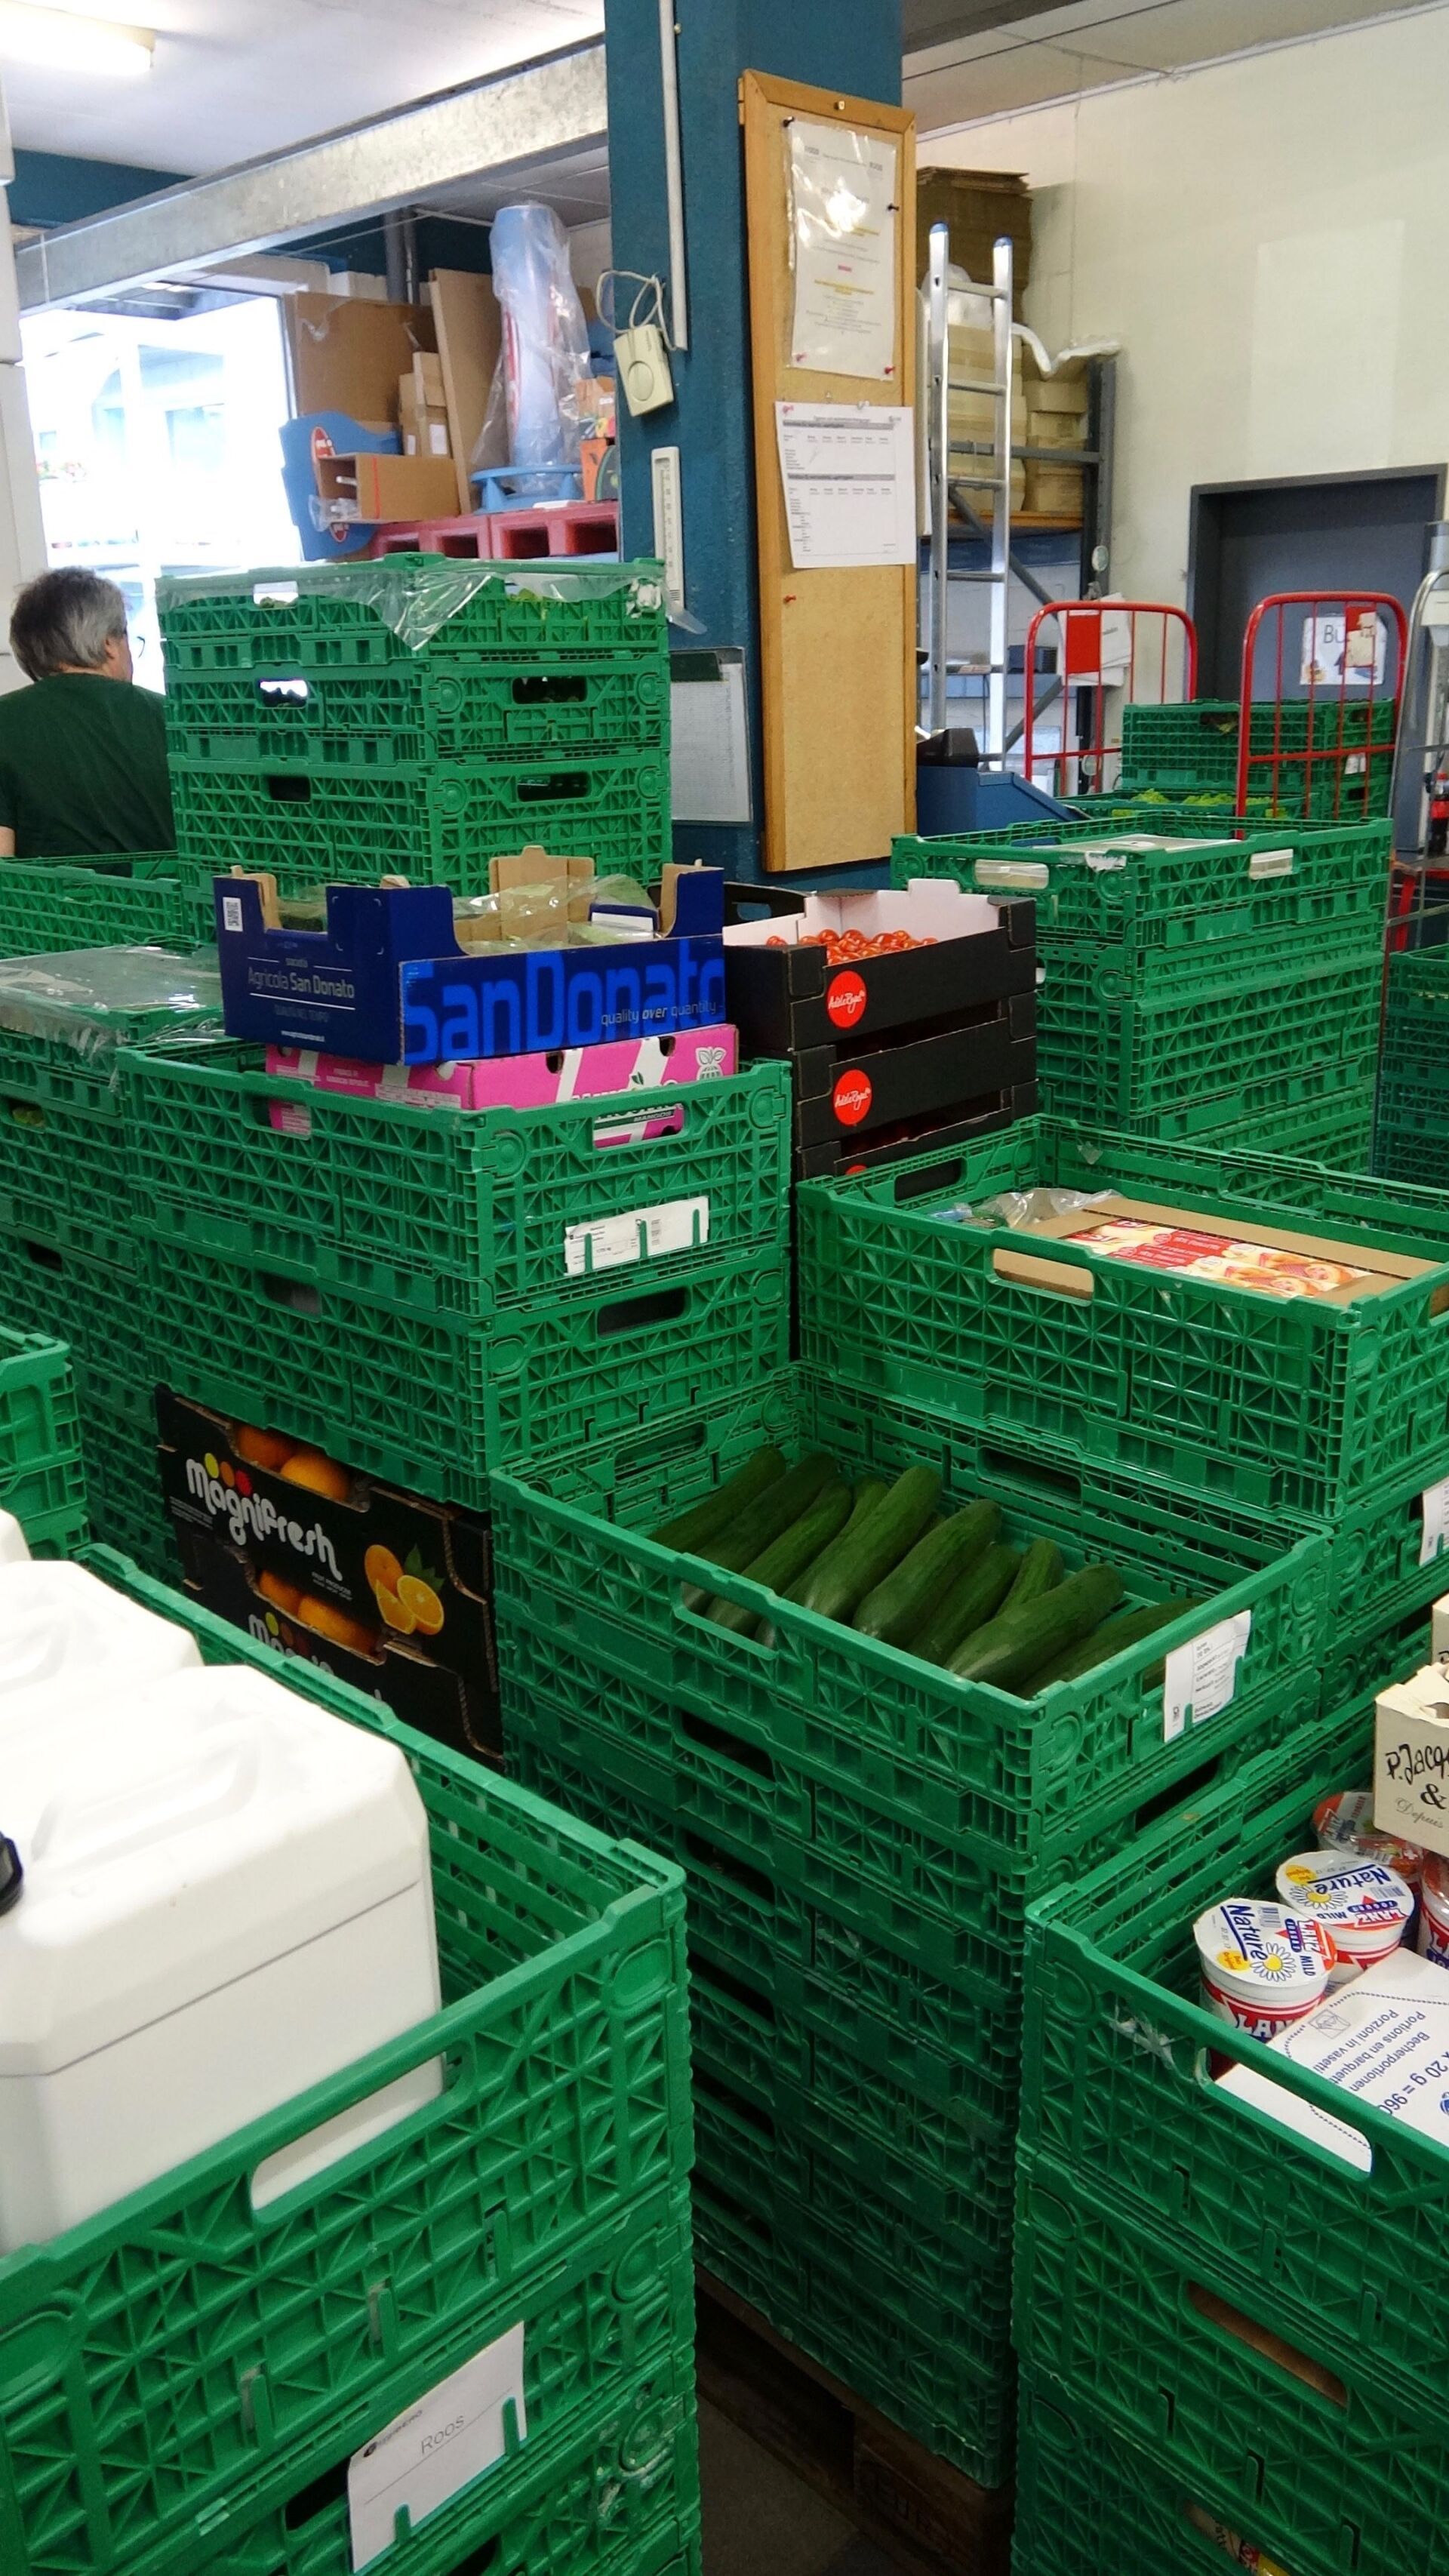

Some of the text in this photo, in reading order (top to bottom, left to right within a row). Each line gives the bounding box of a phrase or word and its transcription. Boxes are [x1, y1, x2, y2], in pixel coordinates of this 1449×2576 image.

[289, 971, 312, 993] San
[312, 974, 355, 999] Donato
[404, 938, 725, 1066] SanDonato
[601, 1001, 716, 1027] quality over quantity
[1385, 1743, 1449, 1786] P.Jacq
[1420, 1784, 1447, 1810] &
[1396, 1797, 1444, 1829] Depuis
[1315, 1867, 1392, 1894] Nature
[1315, 1912, 1347, 1920] MILD
[1356, 1908, 1407, 1923] LANZ
[1226, 1904, 1269, 1961] Nature
[1297, 1920, 1321, 1953] LANZ
[1300, 1956, 1316, 1977] MILD
[1356, 2008, 1399, 2046] Porzioni
[1329, 2011, 1426, 2083] Portions en barquett
[1346, 2040, 1362, 2052] in
[1349, 2030, 1430, 2092] Becherportionen
[1425, 2060, 1448, 2078] 20
[1410, 2073, 1427, 2086] g
